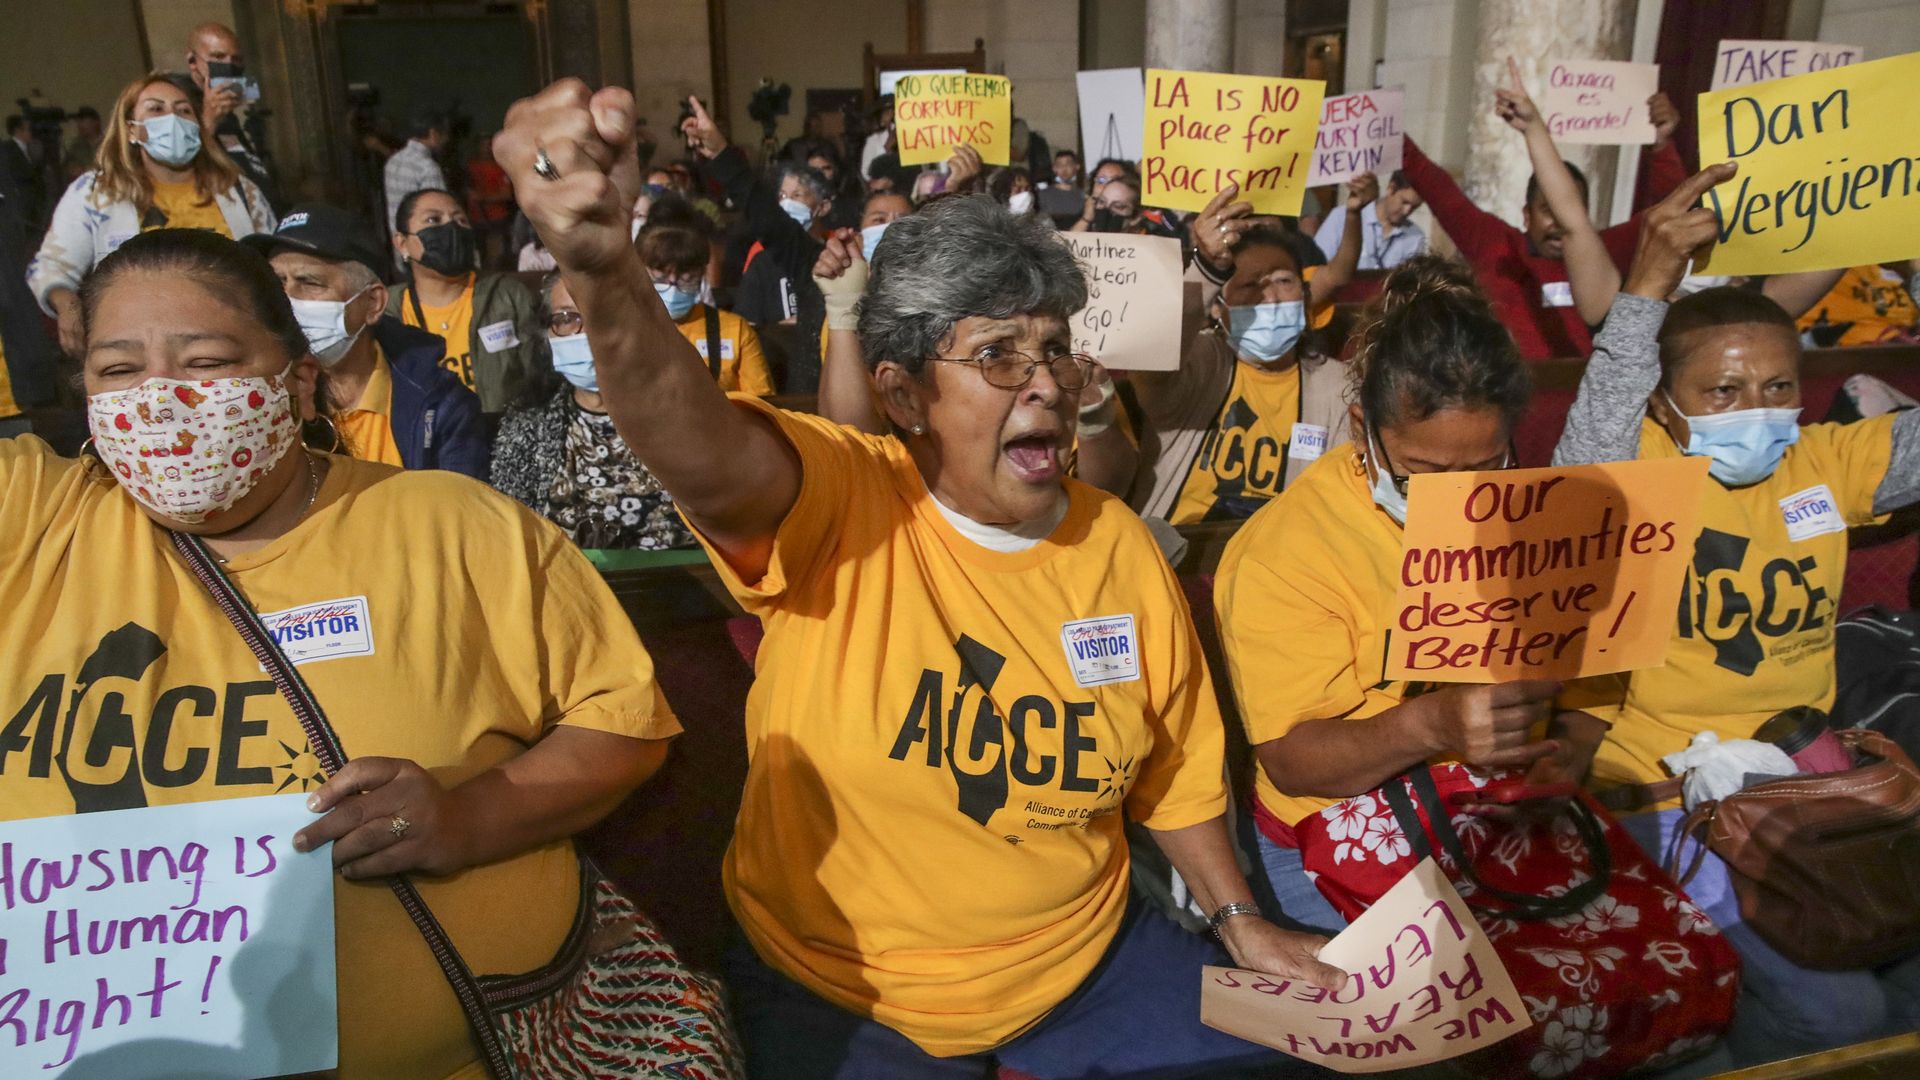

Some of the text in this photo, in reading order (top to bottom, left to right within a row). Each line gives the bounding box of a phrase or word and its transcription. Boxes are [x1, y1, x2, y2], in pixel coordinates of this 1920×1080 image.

[1550, 65, 1616, 91] Oaxaca
[1721, 48, 1798, 83] TAKE
[896, 75, 1009, 98] NO QUEREMOS
[1153, 77, 1190, 108] LA
[1261, 85, 1300, 113] NO
[1577, 93, 1601, 106] es
[898, 99, 981, 121] CORRUPT
[1547, 106, 1632, 137] Grande!
[1723, 89, 1849, 158] Dan
[903, 121, 994, 150] LATINXS
[1160, 114, 1291, 153] place for
[1367, 116, 1399, 140] GIL
[1146, 153, 1299, 194] Racism!
[1319, 146, 1383, 176] KEVIN
[1708, 157, 1920, 253] Vergüen
[1093, 266, 1137, 285] León
[1084, 301, 1128, 331] GO!
[1401, 507, 1676, 587] communities
[1399, 582, 1598, 632] deserve
[269, 615, 359, 646] VISITOR
[1073, 635, 1130, 660] VISITOR
[0, 674, 278, 787] ACCE
[888, 668, 1099, 792] ACCE
[1024, 801, 1065, 817] Alliance
[1067, 807, 1079, 818] of
[45, 905, 248, 963] Human
[1215, 899, 1467, 1005] LEADERS
[1316, 952, 1484, 1038] REAL
